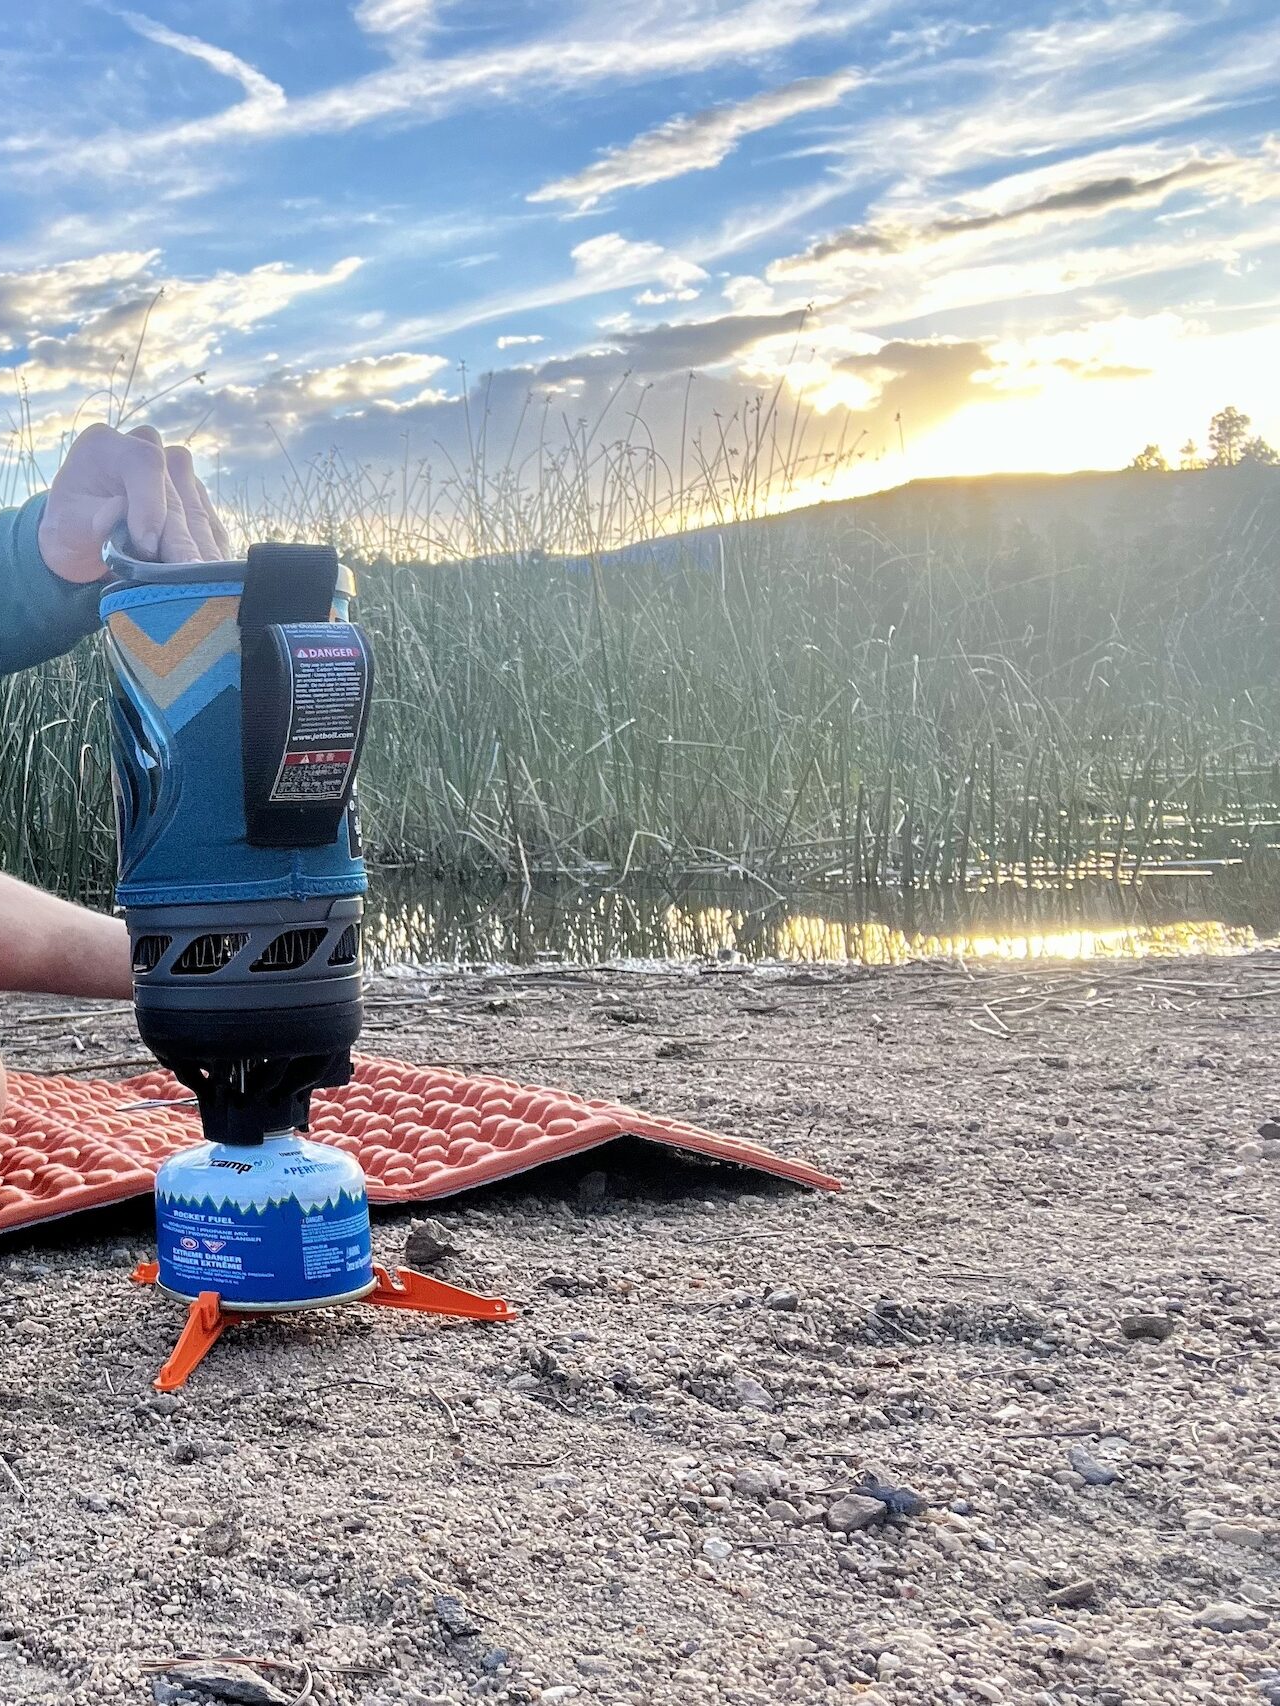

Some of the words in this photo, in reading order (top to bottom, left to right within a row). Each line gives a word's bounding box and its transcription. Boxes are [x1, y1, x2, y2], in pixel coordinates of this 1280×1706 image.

[309, 648, 354, 658] DANGER
[292, 732, 354, 741] www.jetboil.com
[173, 1210, 206, 1222] ROCKET
[208, 1216, 234, 1224] FUEL
[172, 1247, 203, 1259] EXTREME
[205, 1253, 242, 1263] DANGER
[173, 1254, 199, 1265] DANGER
[201, 1259, 242, 1270] EXTRÊME
